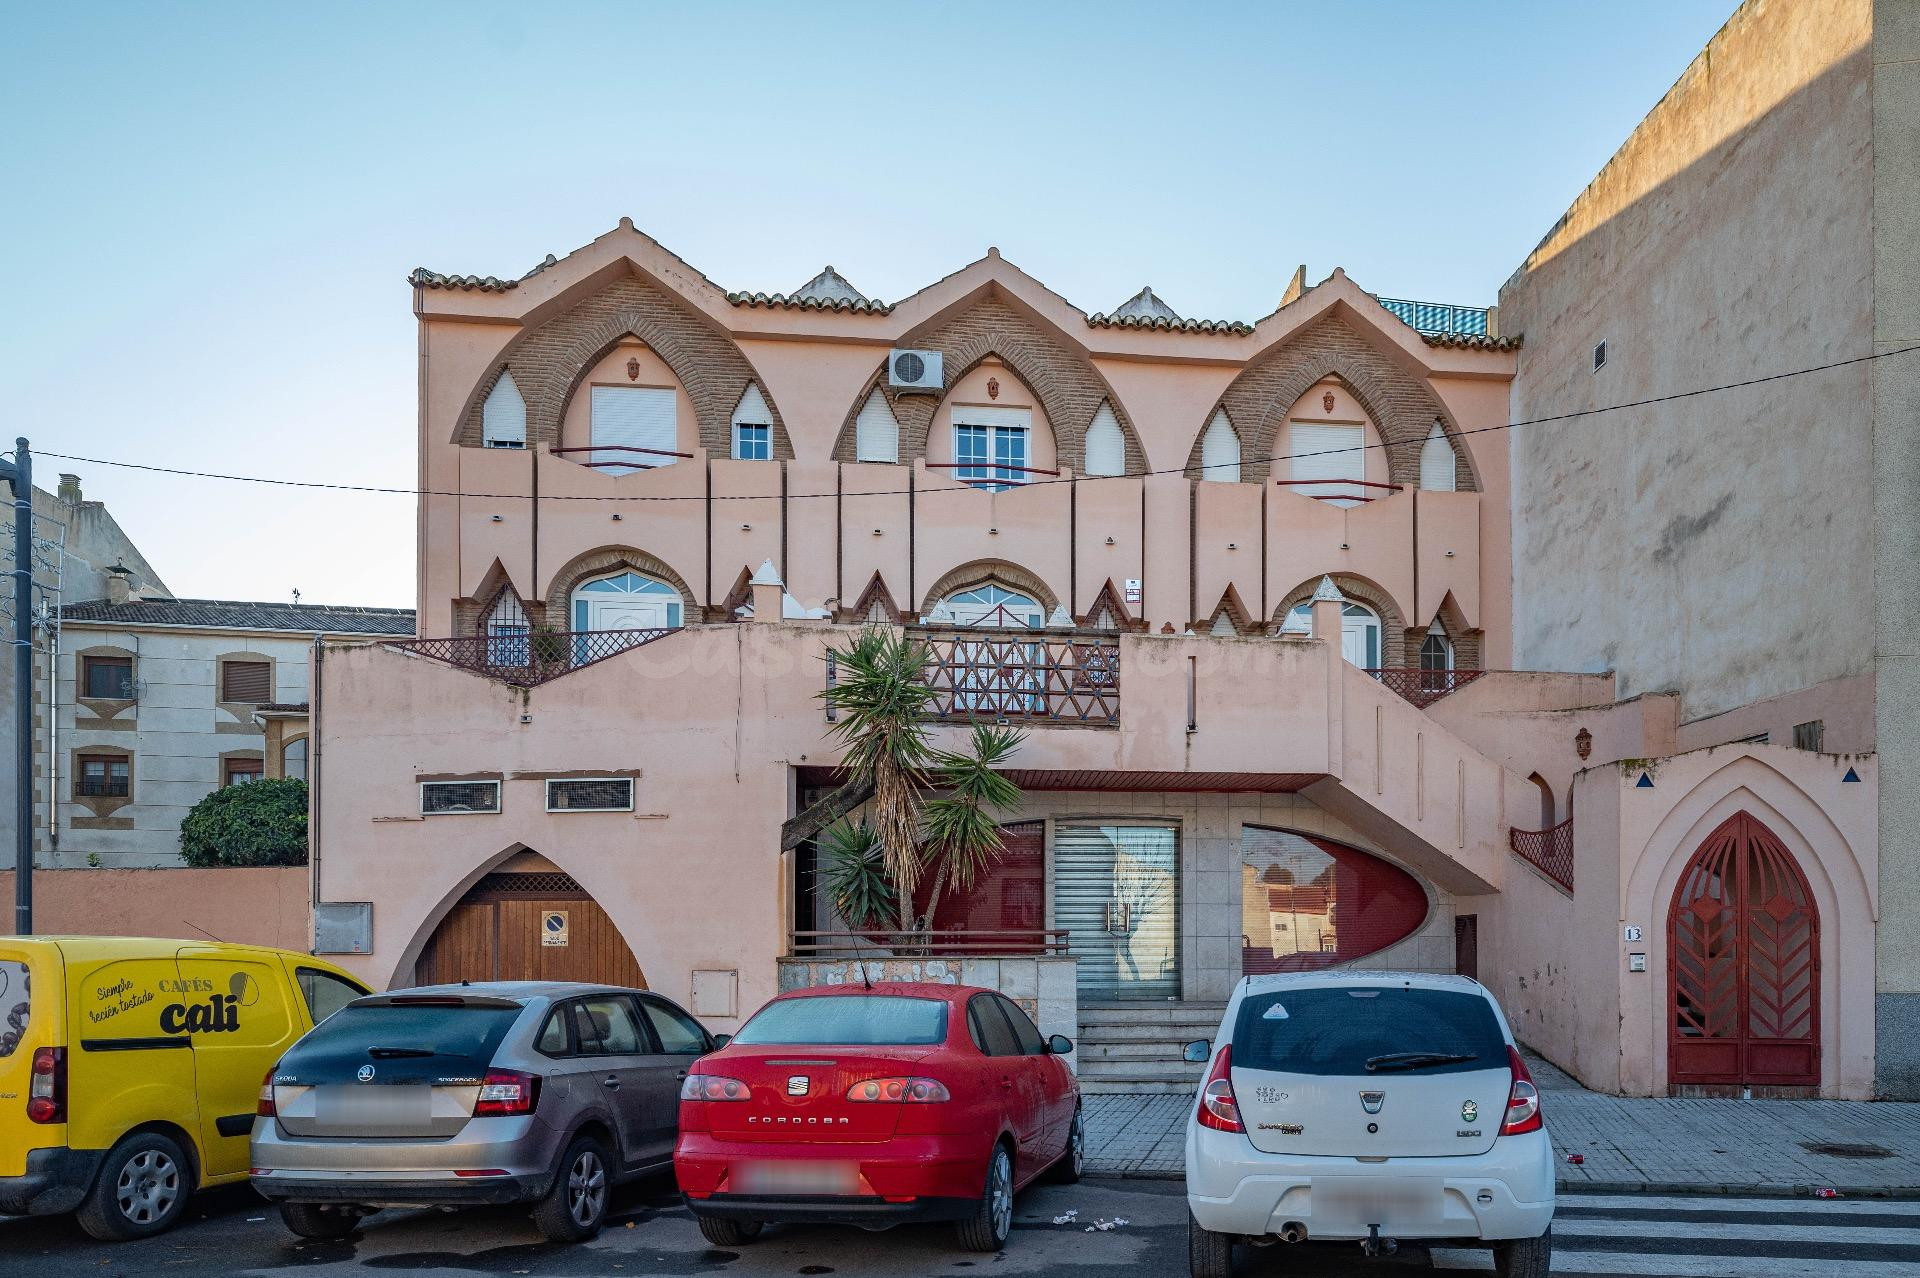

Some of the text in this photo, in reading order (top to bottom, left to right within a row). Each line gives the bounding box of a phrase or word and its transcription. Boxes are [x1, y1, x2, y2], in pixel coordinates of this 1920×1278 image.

[1626, 928, 1642, 940] 13
[96, 978, 134, 1001] Siempre
[158, 977, 213, 993] CAFÉS
[119, 989, 154, 1012] tostado
[159, 994, 241, 1034] cali
[748, 1116, 849, 1124] CORDOBA
